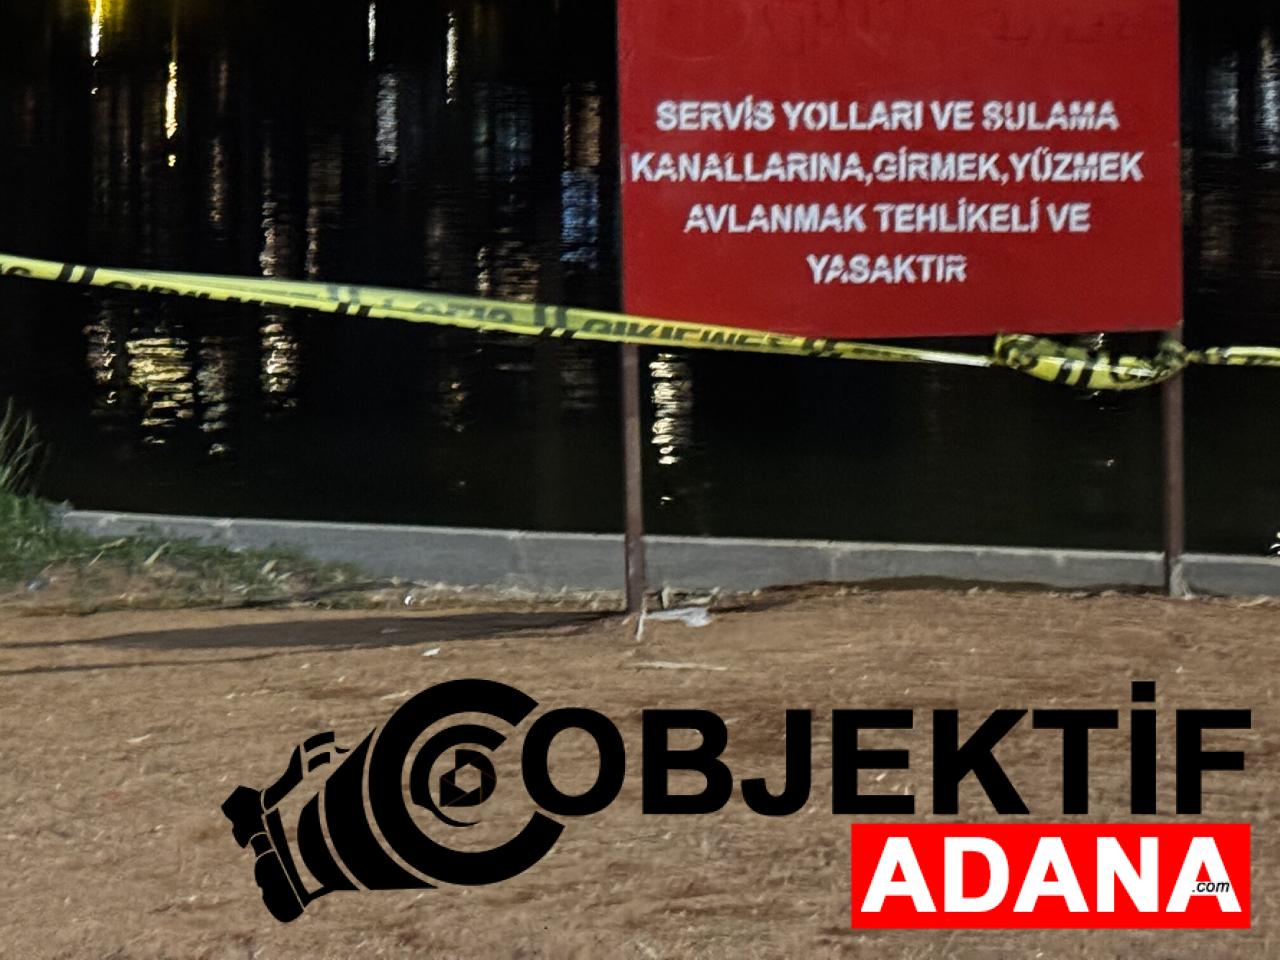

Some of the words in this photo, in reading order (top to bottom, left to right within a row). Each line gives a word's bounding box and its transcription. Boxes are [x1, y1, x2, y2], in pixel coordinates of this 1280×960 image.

[655, 94, 775, 131] SERVİS
[781, 100, 924, 131] YOLLARI
[929, 100, 974, 131] VE
[982, 100, 1120, 131] SULAMA
[683, 203, 867, 233] AVLANMAK
[873, 196, 1039, 233] TEHLİKELİ
[1046, 202, 1091, 233] VE
[806, 254, 967, 284] YASAKTIR
